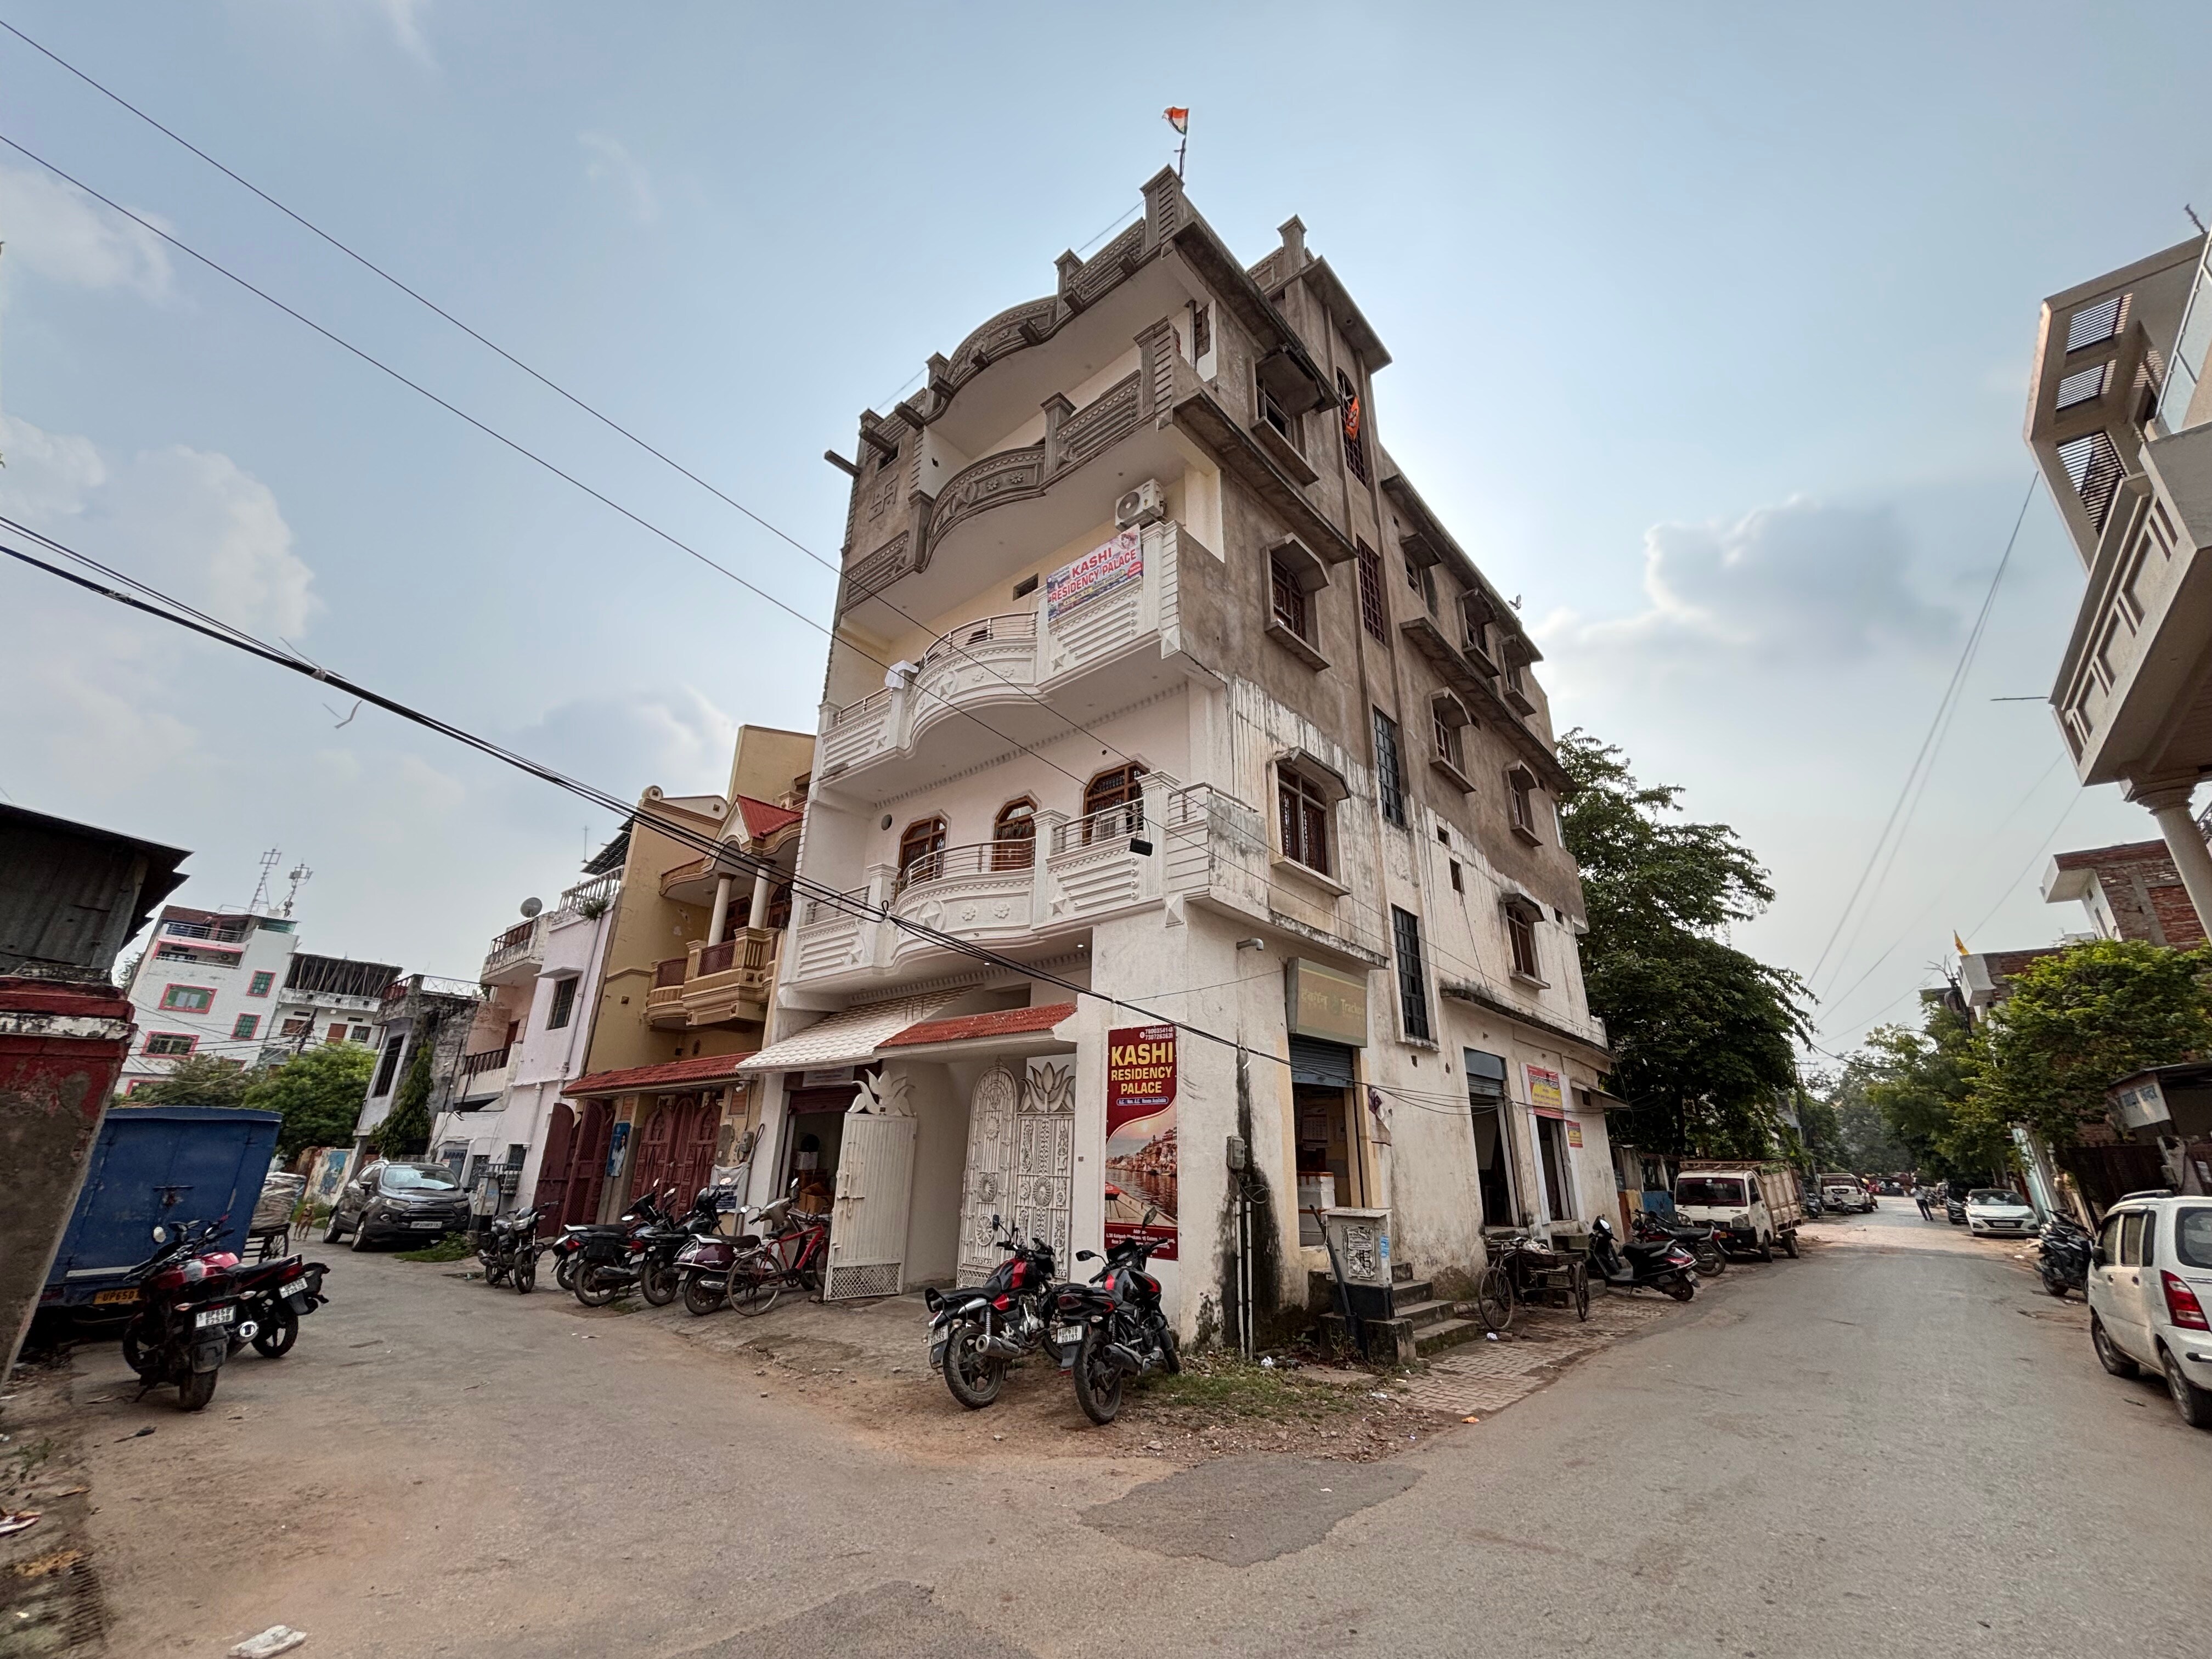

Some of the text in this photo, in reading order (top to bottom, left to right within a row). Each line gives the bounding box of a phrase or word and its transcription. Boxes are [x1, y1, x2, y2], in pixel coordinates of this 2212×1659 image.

[1072, 548, 1111, 578] KASHI
[1052, 569, 1099, 603] RESIDENCY
[1102, 549, 1136, 575] PALACE
[1111, 1041, 1173, 1066] KASHI
[1111, 1066, 1173, 1081] RESIDENCY
[1120, 1081, 1162, 1094] PALACE
